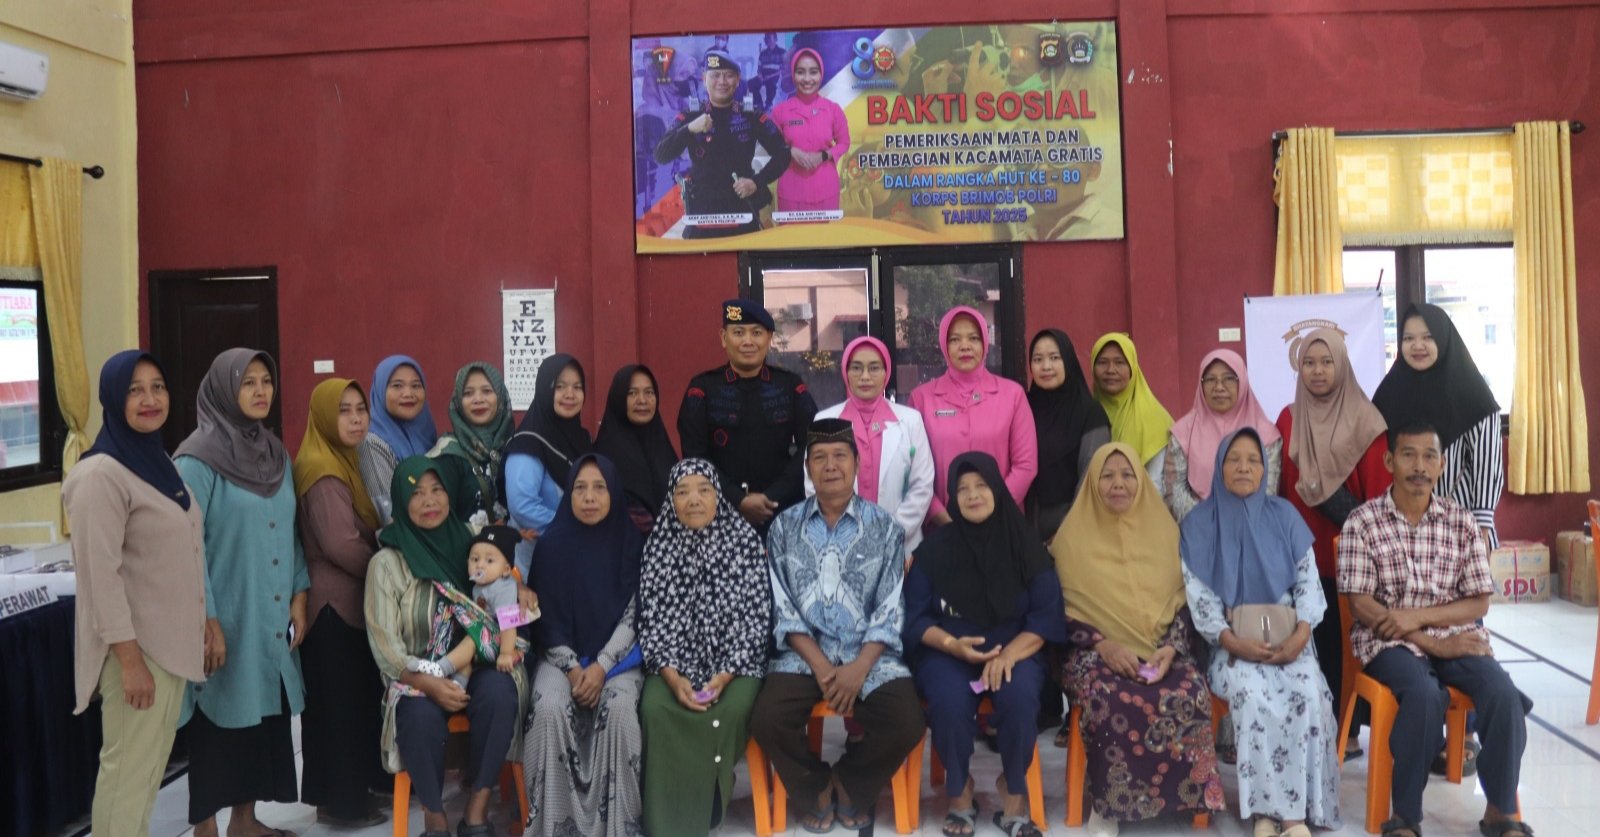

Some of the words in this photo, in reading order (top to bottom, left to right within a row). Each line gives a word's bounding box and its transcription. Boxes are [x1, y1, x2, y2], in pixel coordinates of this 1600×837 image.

[867, 94, 967, 125] BAKTI
[975, 89, 1096, 121] SOSIAL
[884, 131, 993, 149] PEMERIKSAAN
[997, 130, 1042, 146] MATA
[1046, 129, 1080, 144] DAN
[858, 151, 950, 168] PEMBAGIAN
[954, 149, 1043, 166] KACAMATA
[1047, 147, 1103, 163] GRATIS
[884, 173, 934, 189] DALAM
[936, 172, 996, 188] RANGKA
[999, 171, 1026, 186] HUT
[1028, 171, 1046, 185] KE
[1062, 169, 1081, 184] 80
[911, 191, 958, 207] KORPS
[960, 190, 1016, 206] BRIMOB
[1018, 188, 1057, 204] POLRI
[943, 209, 991, 225] TAHUN
[993, 208, 1028, 223] 2025
[0, 295, 33, 310] TIARA
[520, 300, 536, 316] E
[512, 320, 524, 332] N
[531, 319, 544, 332] Z
[511, 336, 520, 346] Y
[524, 336, 534, 346] L
[537, 336, 546, 346] V
[1503, 577, 1538, 597] SDL
[0, 586, 51, 616] PERAWAT
